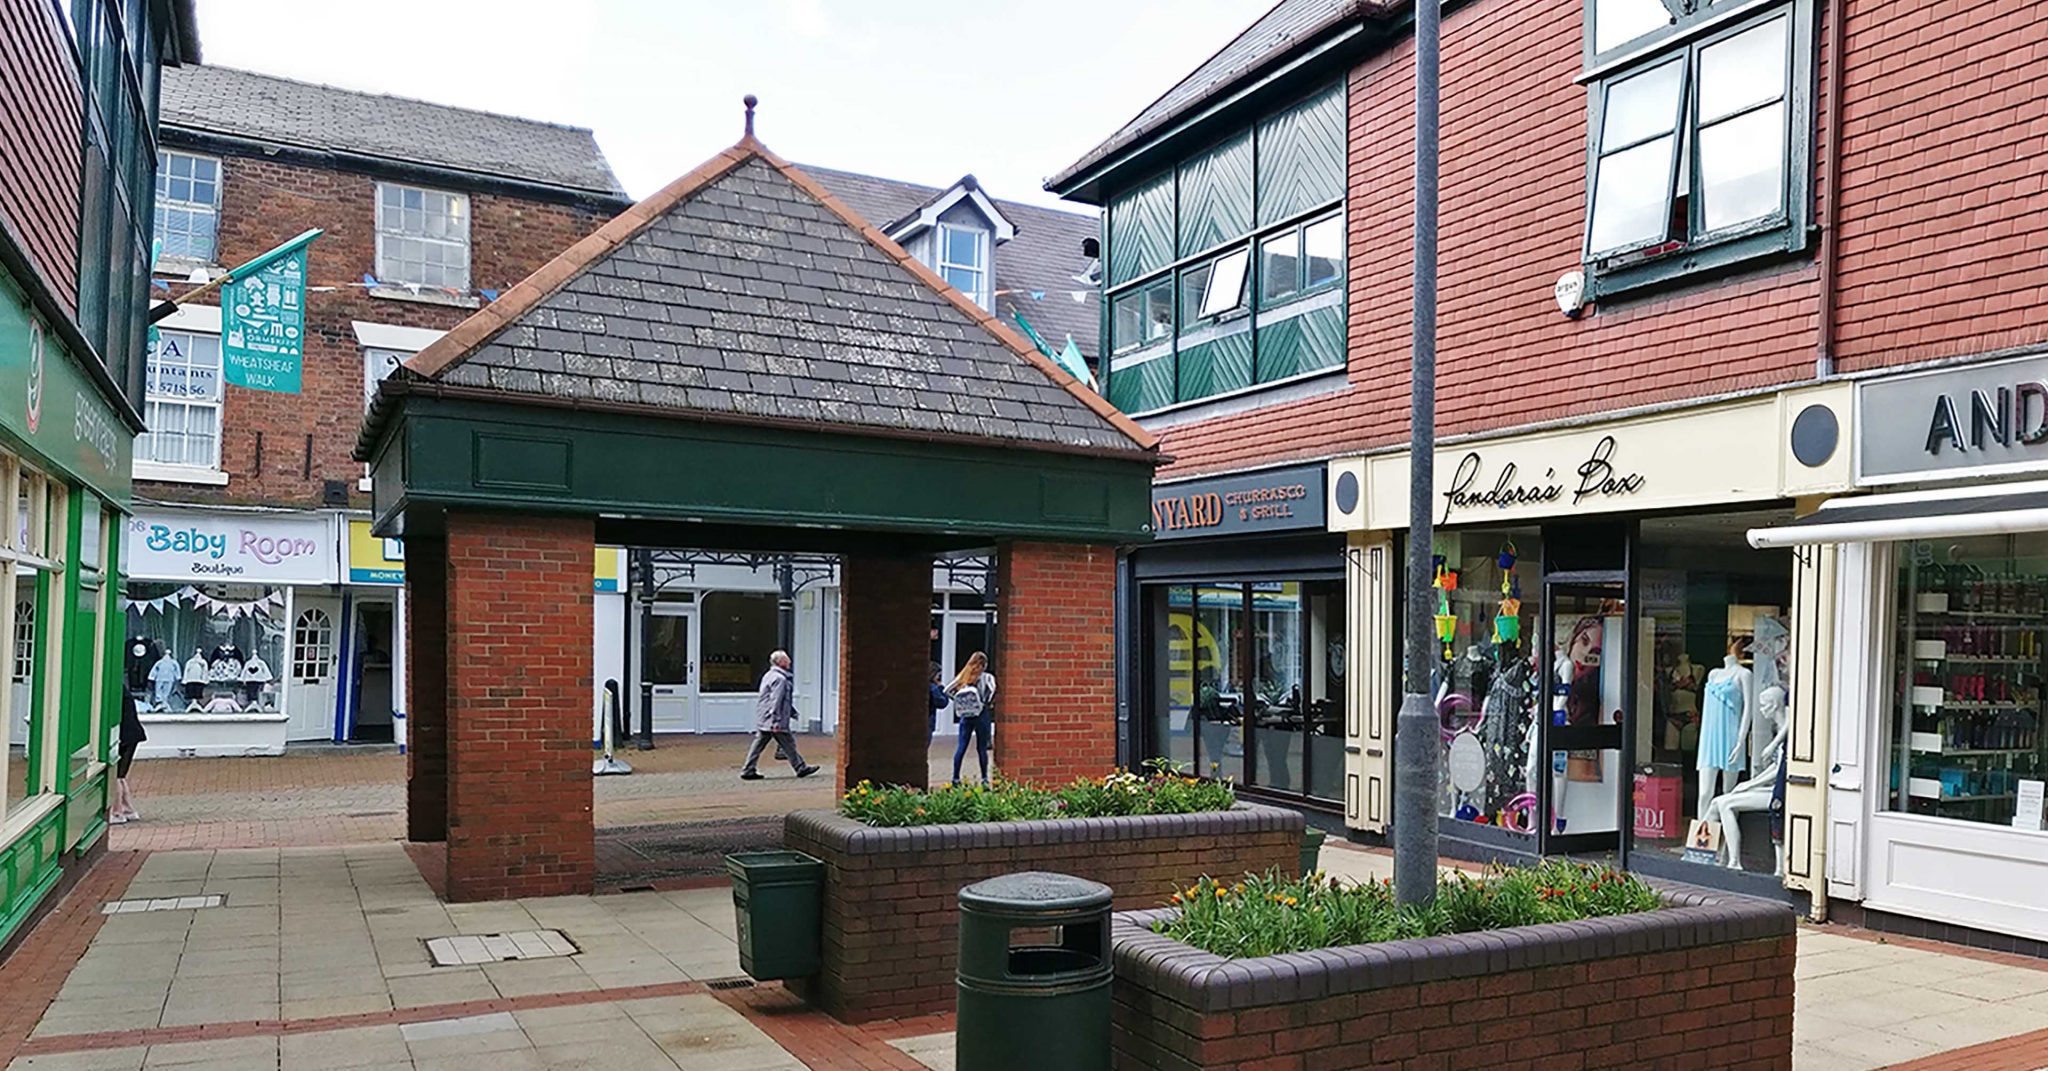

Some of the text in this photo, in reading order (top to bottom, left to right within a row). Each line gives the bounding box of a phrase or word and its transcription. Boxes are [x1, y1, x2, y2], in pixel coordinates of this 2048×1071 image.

[228, 353, 294, 374] WHEATSHEAF
[245, 373, 276, 388] WALK
[1925, 381, 2048, 455] AND
[1442, 435, 1645, 527] Pandora's Box
[1225, 484, 1306, 506] CHURRASCO
[1252, 503, 1294, 520] GRILL
[146, 524, 227, 560] Baby
[239, 529, 317, 565] Room
[191, 562, 244, 576] Boutique
